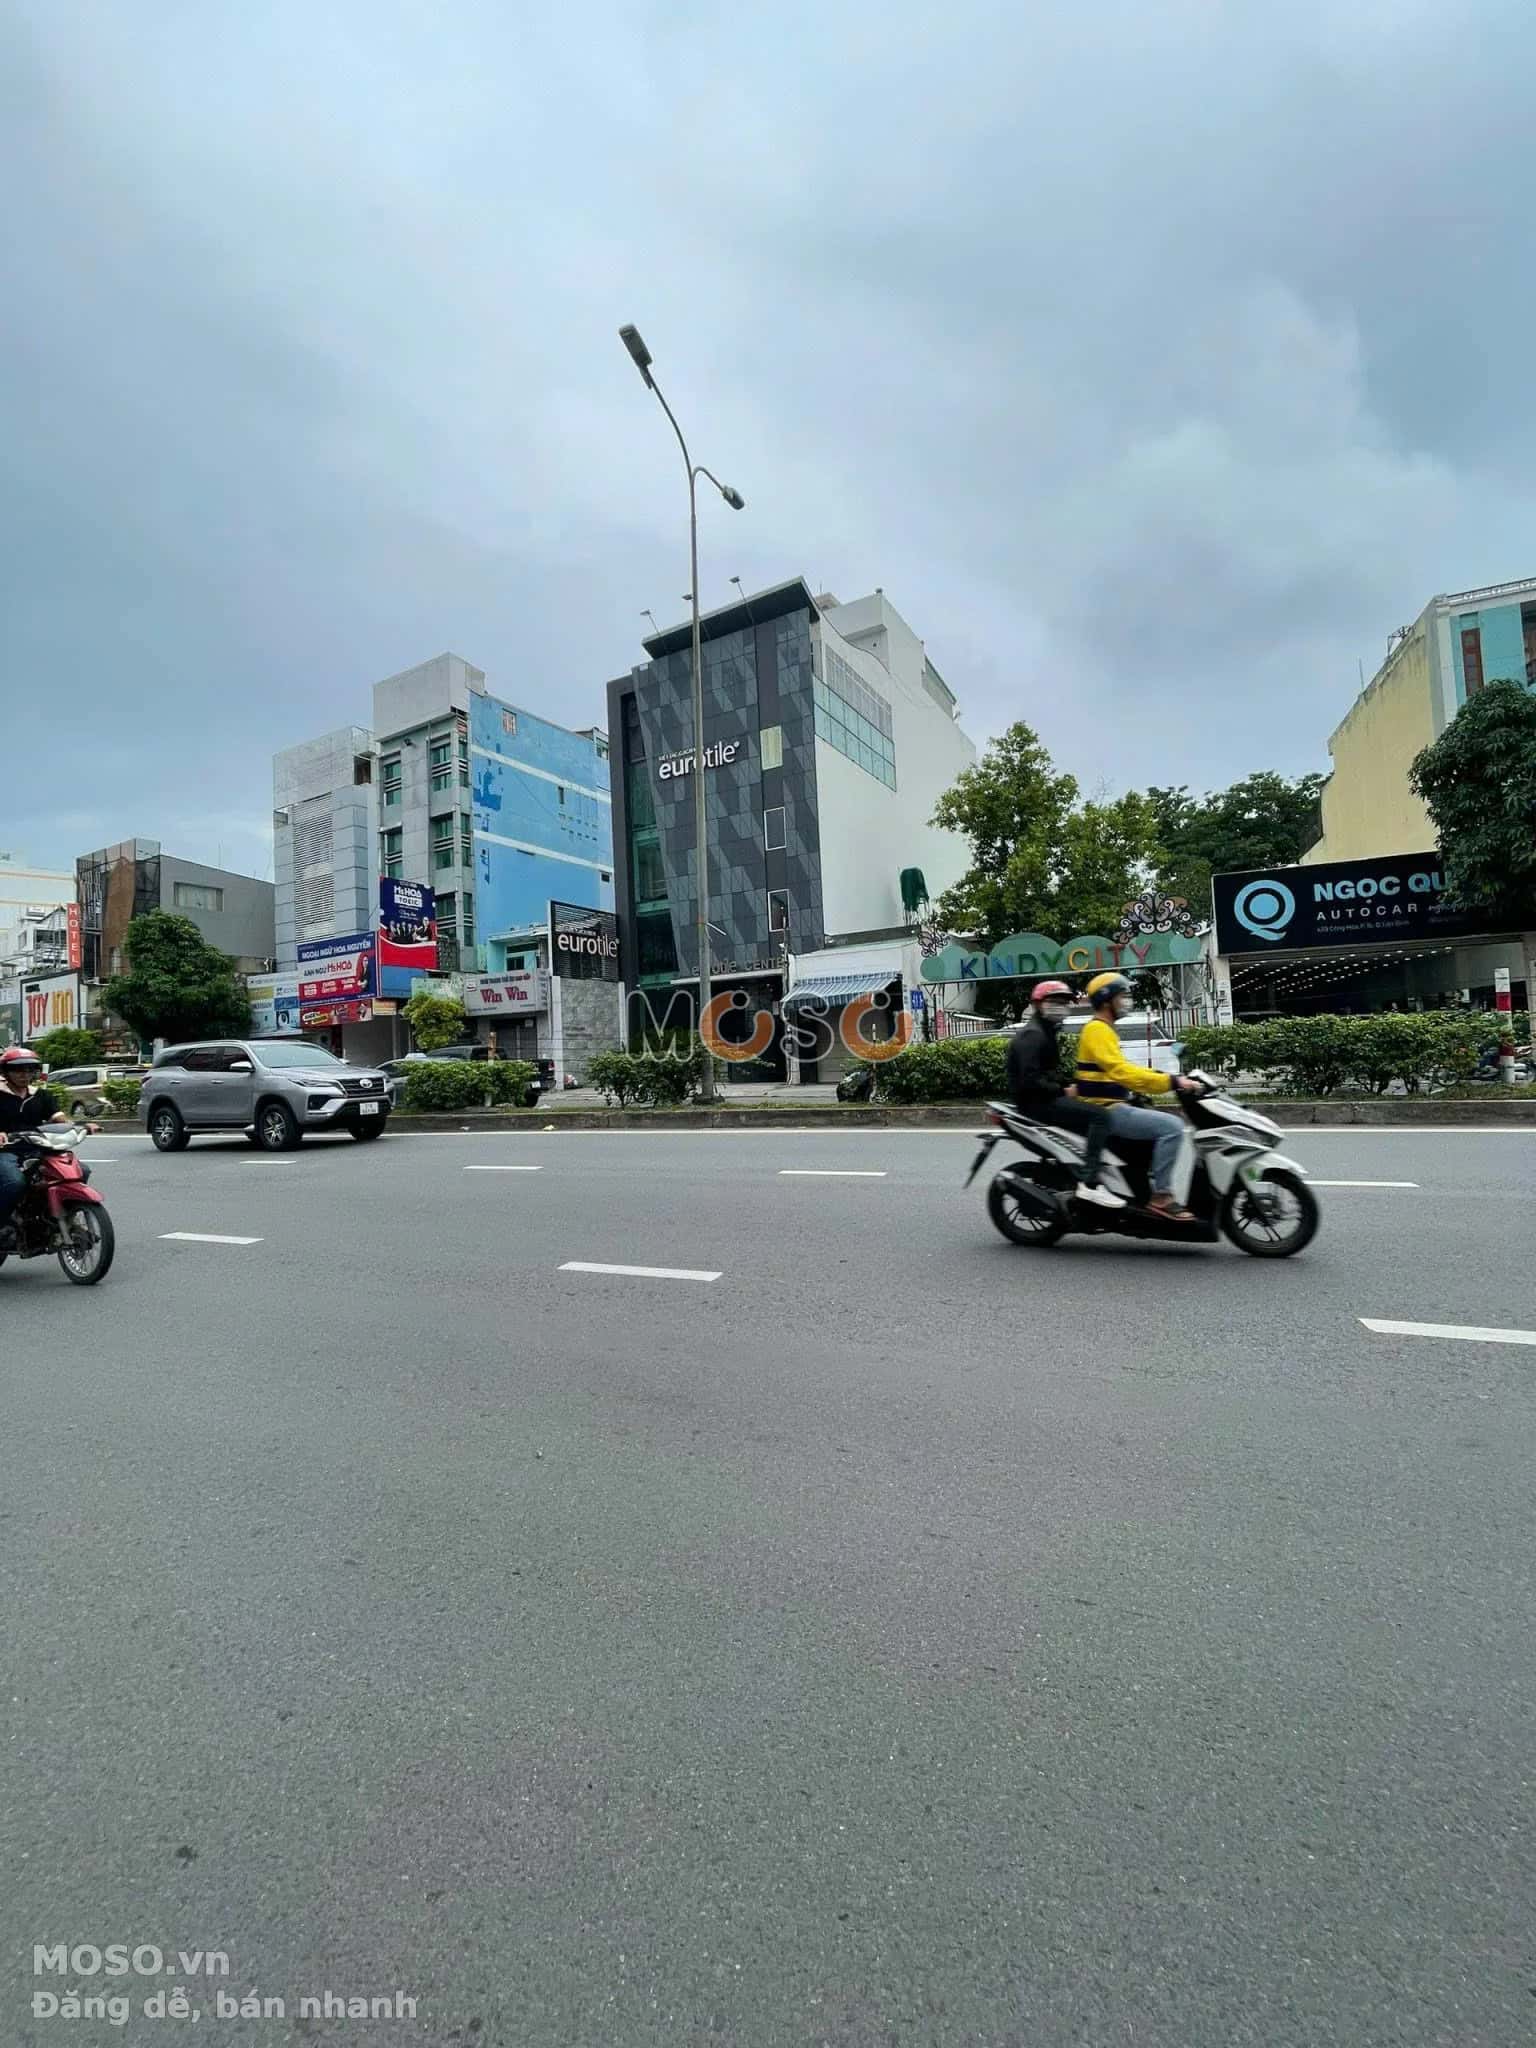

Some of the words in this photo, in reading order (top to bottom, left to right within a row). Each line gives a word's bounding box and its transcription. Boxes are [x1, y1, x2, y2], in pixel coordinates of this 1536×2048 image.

[1313, 876, 1401, 903] NGỌC
[1316, 903, 1418, 921] AUTOCAR
[69, 908, 79, 963] HOTEL
[557, 933, 617, 958] eurotile
[480, 988, 503, 1003] Win
[504, 986, 528, 1000] Win
[26, 992, 49, 1037] JOY
